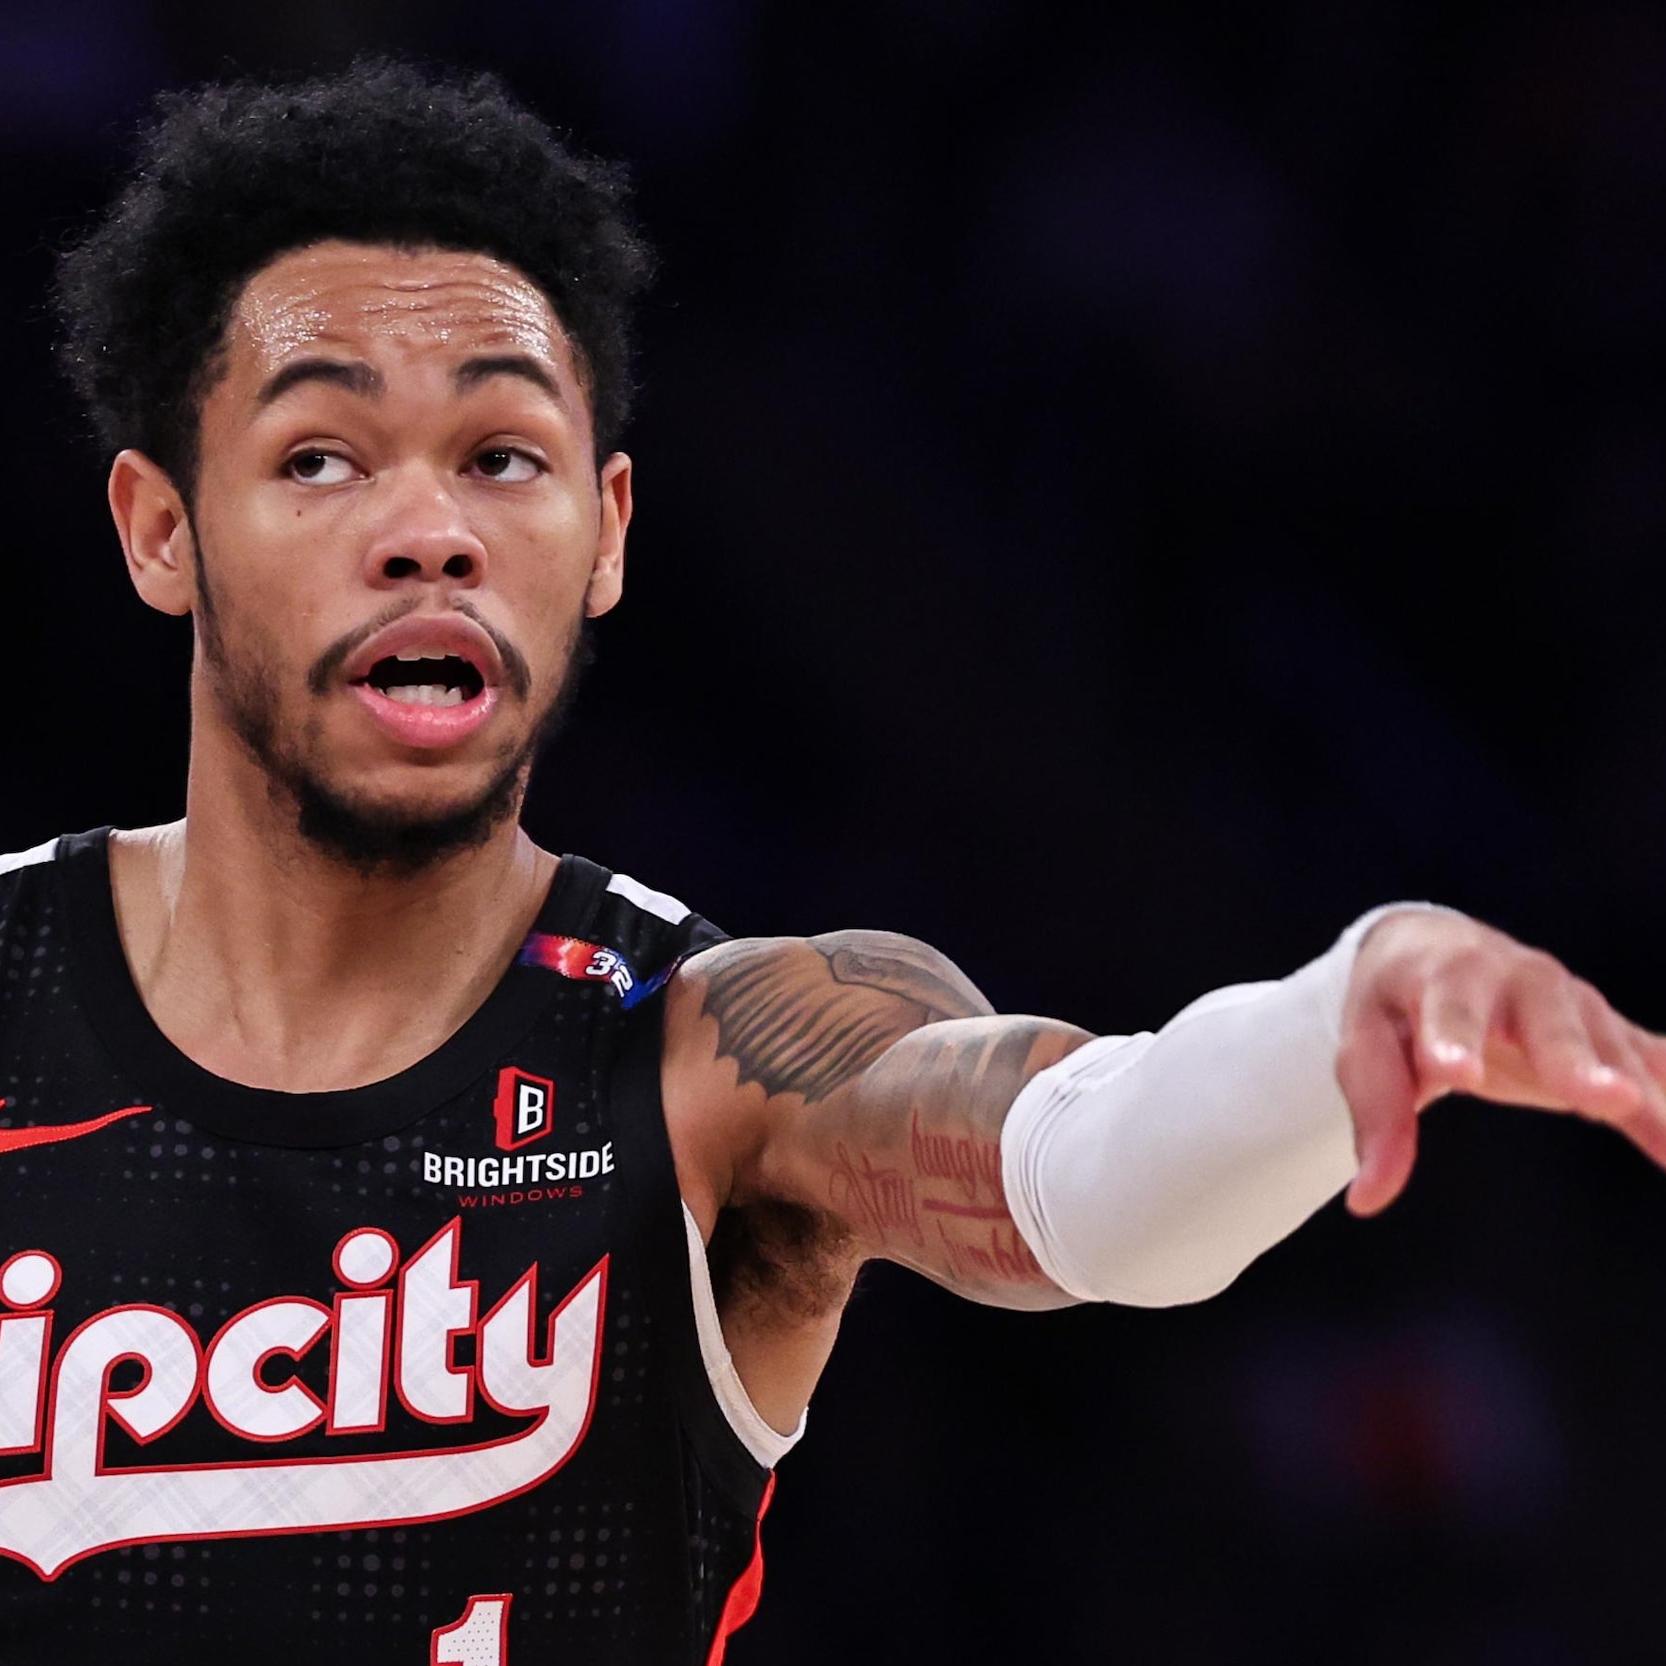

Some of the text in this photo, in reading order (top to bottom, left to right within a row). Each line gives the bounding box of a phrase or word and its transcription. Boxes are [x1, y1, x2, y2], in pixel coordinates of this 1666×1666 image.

[585, 951, 634, 998] 32
[517, 1083, 545, 1135] B
[423, 1141, 615, 1188] BRIGHTSIDE
[458, 1186, 583, 1208] WINDOWS
